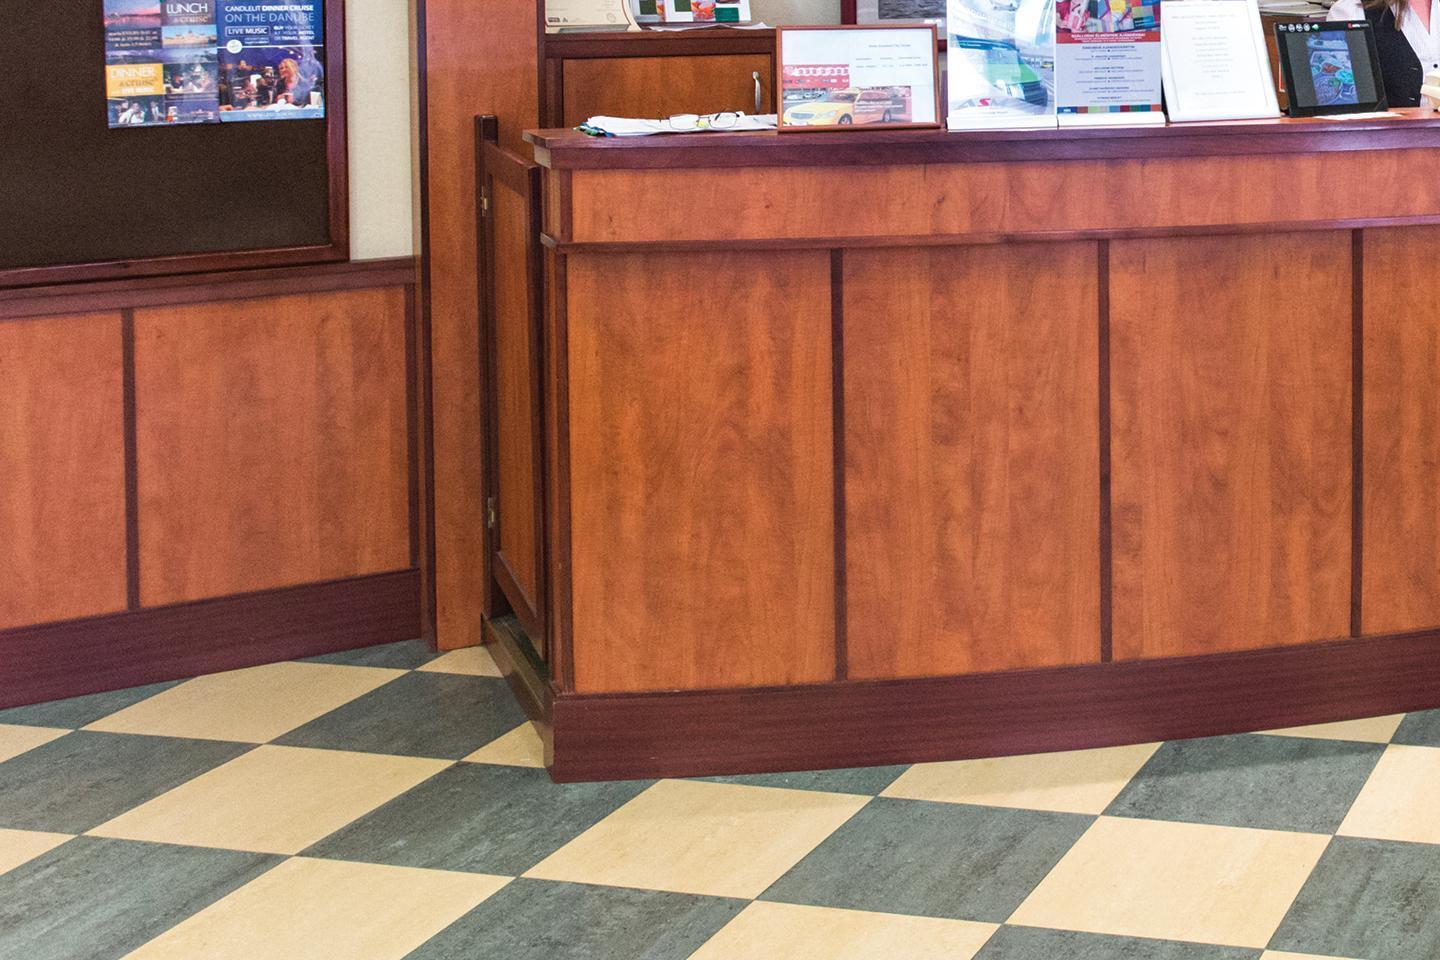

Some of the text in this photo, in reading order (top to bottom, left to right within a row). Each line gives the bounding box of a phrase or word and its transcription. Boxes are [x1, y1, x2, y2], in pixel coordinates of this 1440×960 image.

[166, 2, 208, 14] LUNCH
[225, 12, 314, 22] ON THE DANUBE
[109, 66, 155, 80] DINNER
